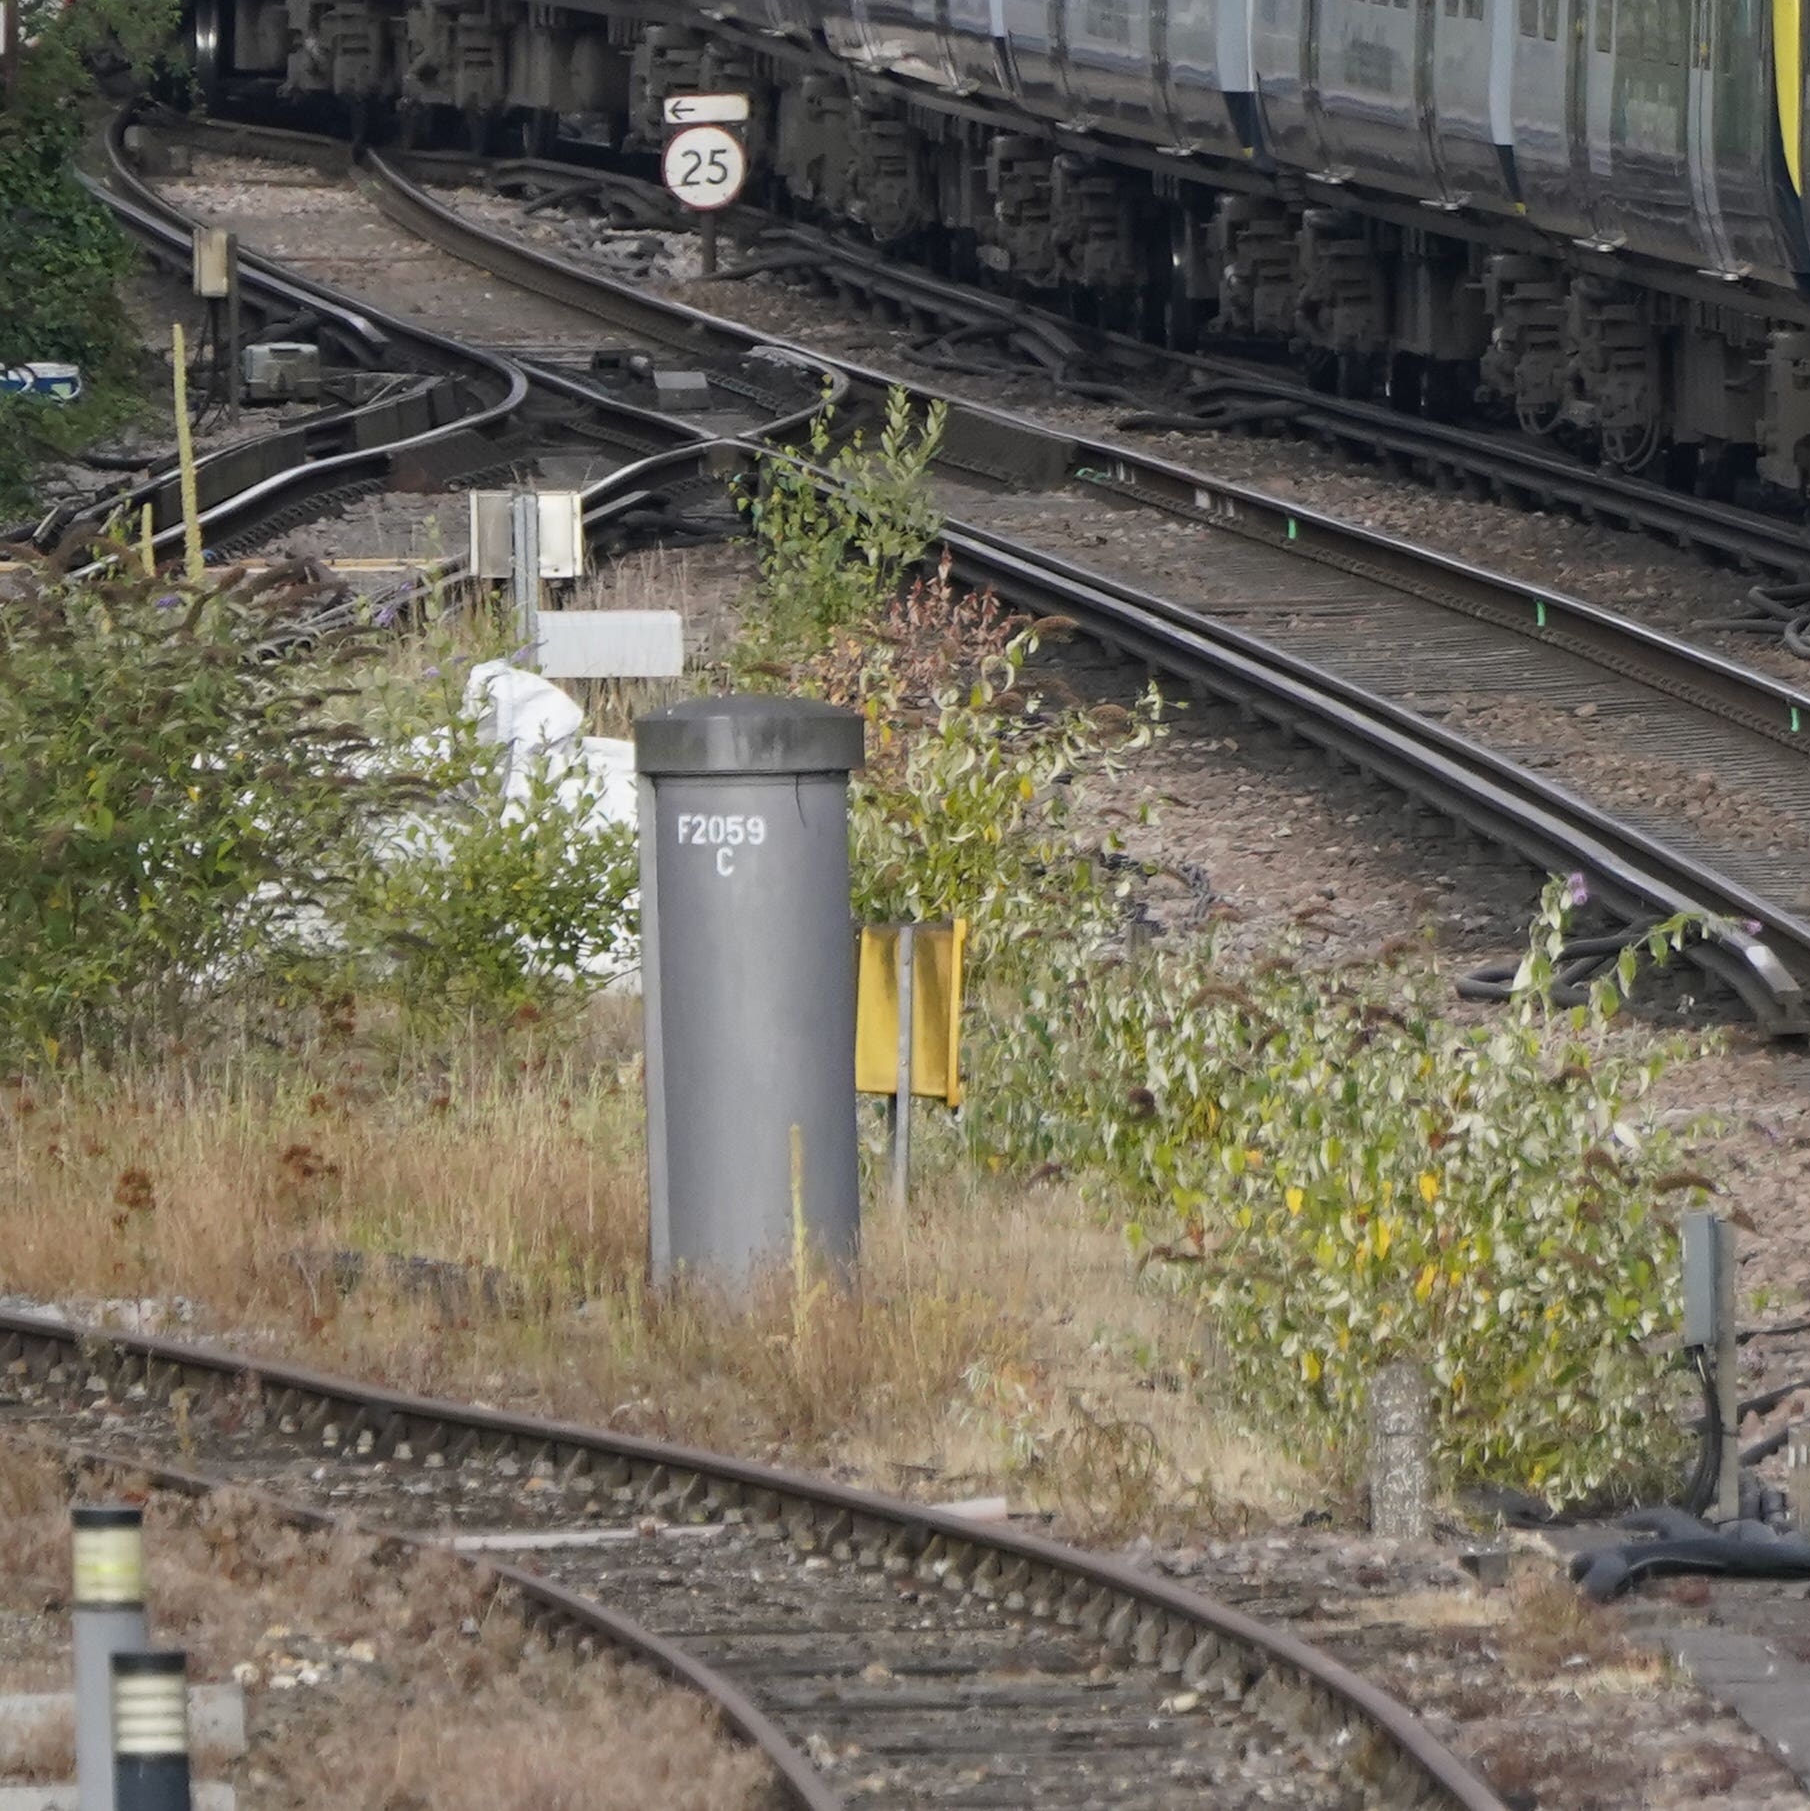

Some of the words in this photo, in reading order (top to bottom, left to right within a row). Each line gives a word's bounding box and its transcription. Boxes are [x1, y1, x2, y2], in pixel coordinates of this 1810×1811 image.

[681, 149, 728, 185] 25
[678, 814, 767, 845] F2059
[717, 846, 735, 878] C
